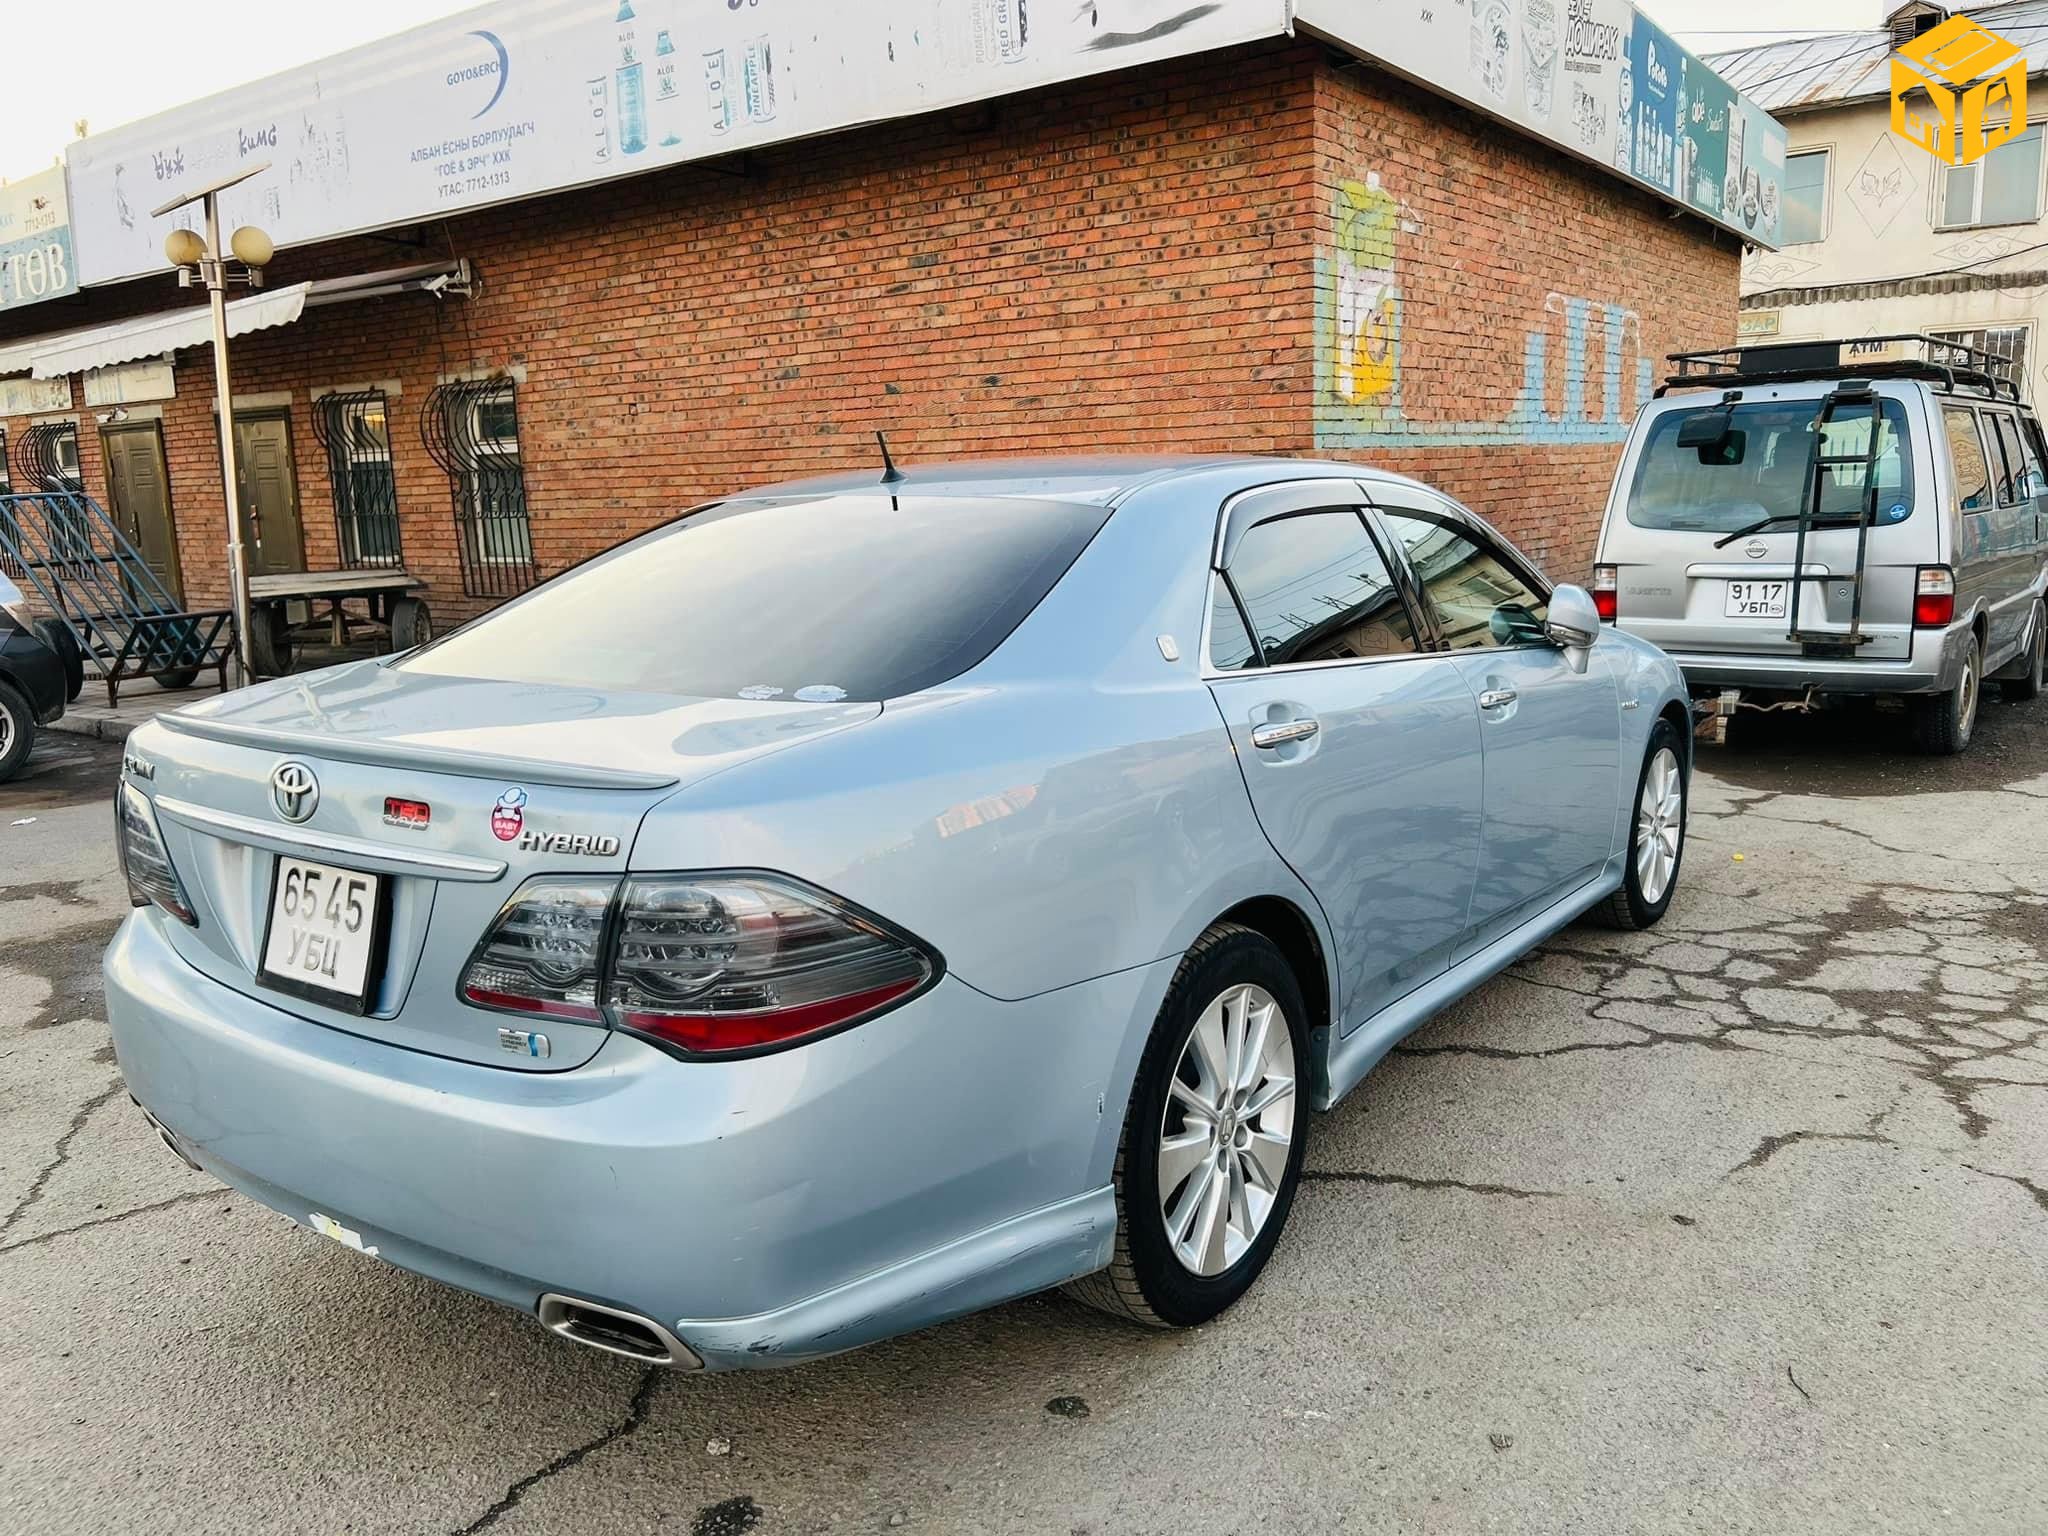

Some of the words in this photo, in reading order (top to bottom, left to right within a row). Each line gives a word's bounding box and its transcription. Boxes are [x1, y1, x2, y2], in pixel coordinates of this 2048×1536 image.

[1565, 17, 1620, 61] ДОШИРАК
[657, 65, 676, 76] ALOE
[410, 147, 441, 163] АЛБАН
[472, 121, 535, 149] БОРЛУУЛАГЧ
[459, 161, 466, 173] &
[492, 149, 512, 166] ХХК
[437, 181, 464, 198] УТАС:
[466, 170, 511, 193] 7712-1313
[8, 243, 67, 300] ТӨВ
[1739, 317, 1776, 332] ЗАР
[1848, 342, 1882, 354] ATM
[1732, 584, 1752, 600] 91
[1761, 583, 1783, 601] 17
[1738, 602, 1768, 614] УБП
[495, 820, 518, 831] BABY
[520, 832, 620, 857] HYBRID
[287, 927, 342, 980] УБЦ
